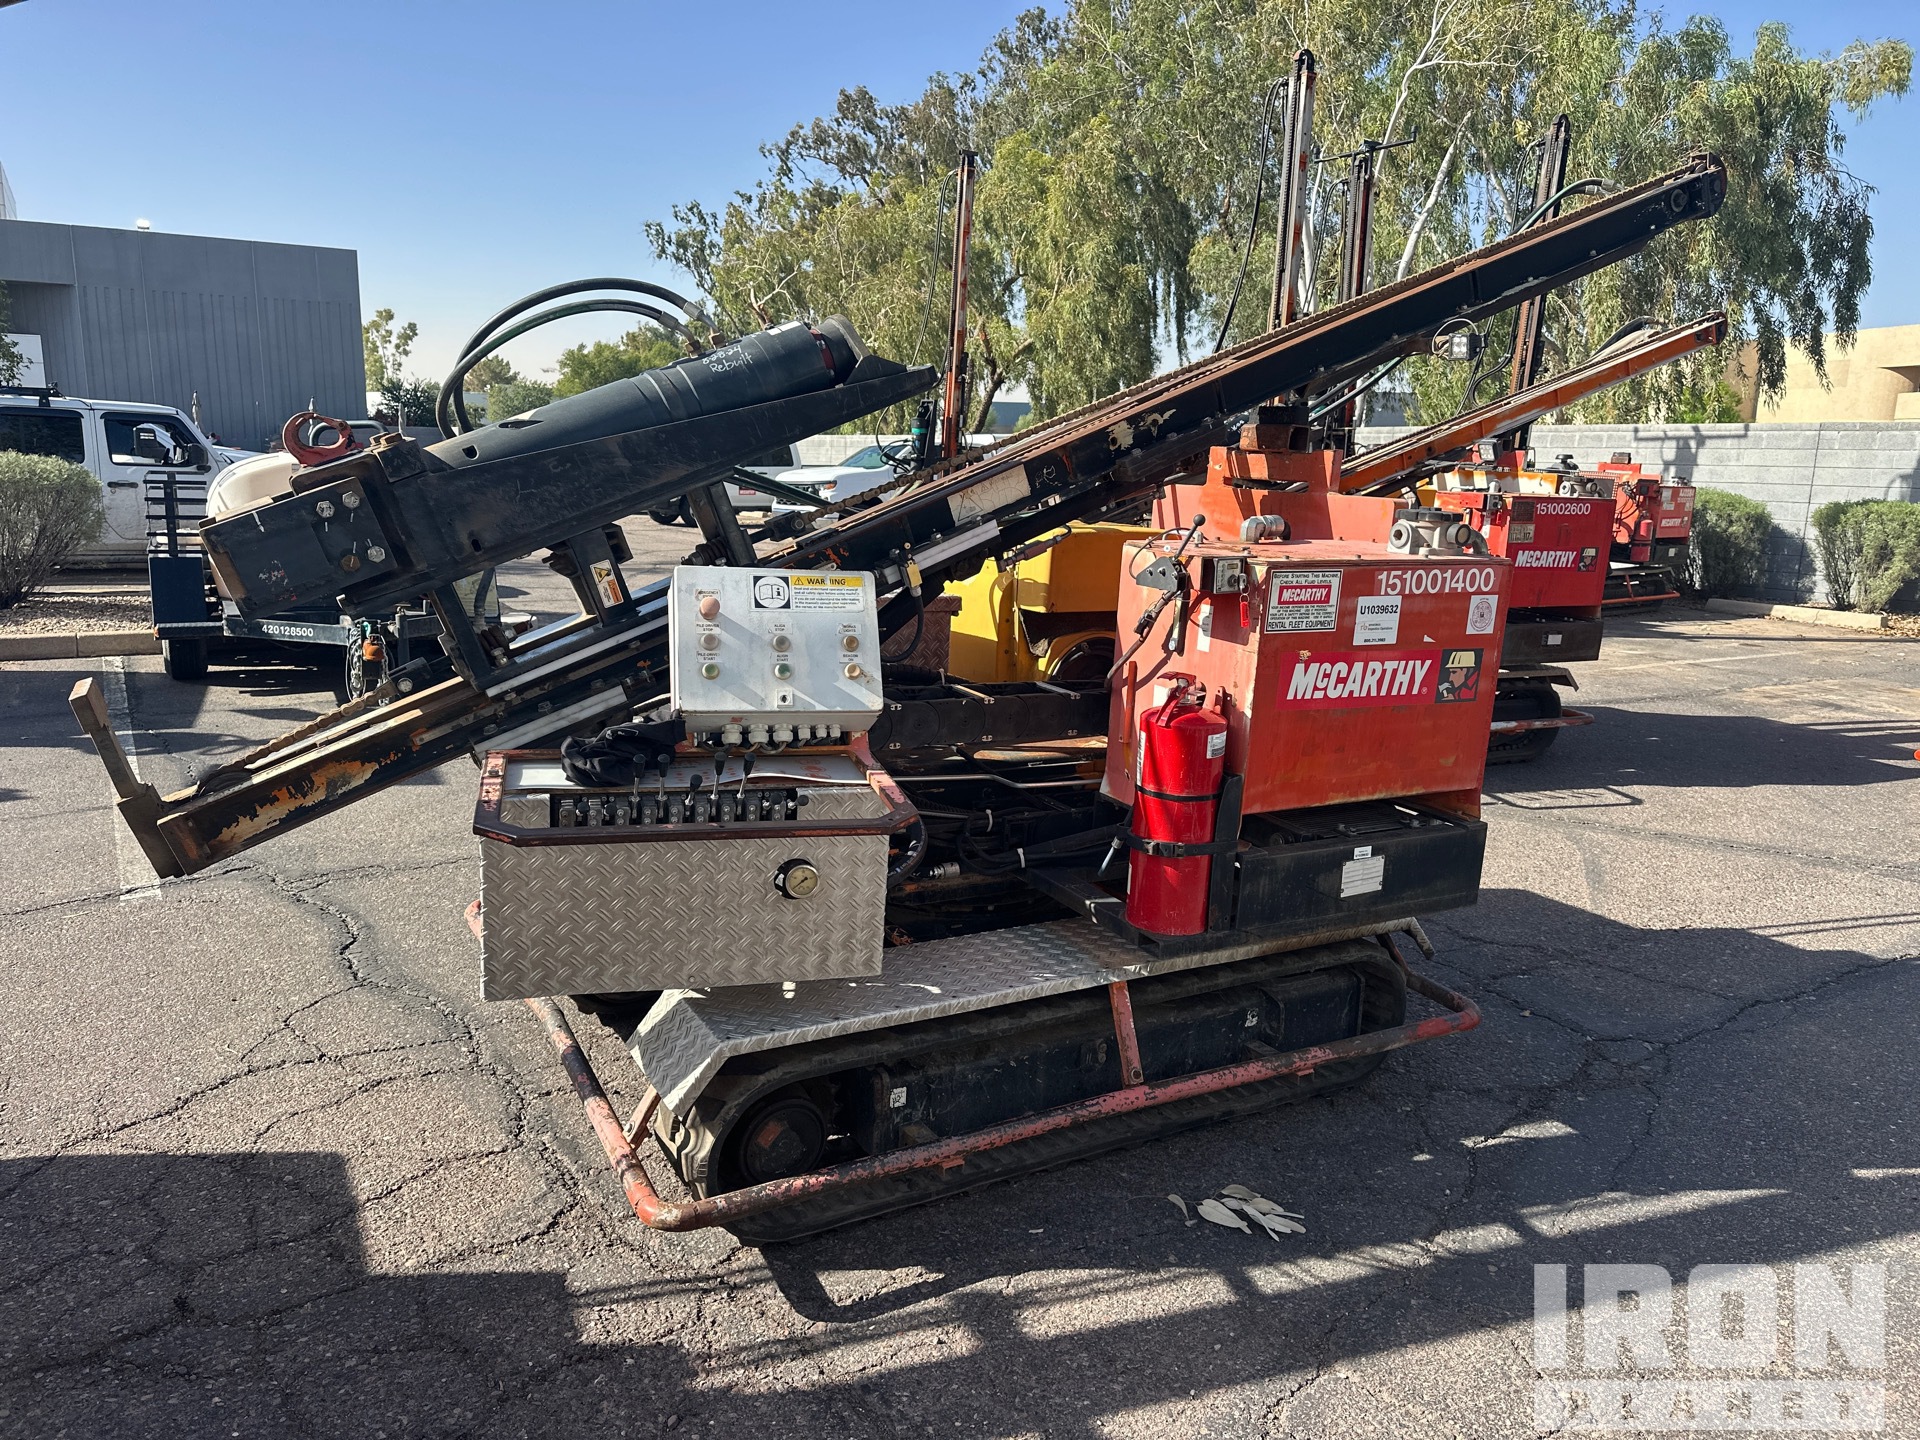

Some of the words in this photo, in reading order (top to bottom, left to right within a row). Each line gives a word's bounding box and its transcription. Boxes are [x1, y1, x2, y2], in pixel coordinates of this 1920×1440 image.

[709, 352, 753, 373] Rebuilt
[1536, 503, 1591, 515] 151002600
[806, 577, 846, 586] WARING
[1377, 568, 1495, 595] 151001400
[1360, 604, 1399, 615] U1039632
[262, 624, 314, 637] 420128500
[1286, 660, 1432, 700] McCARTHY
